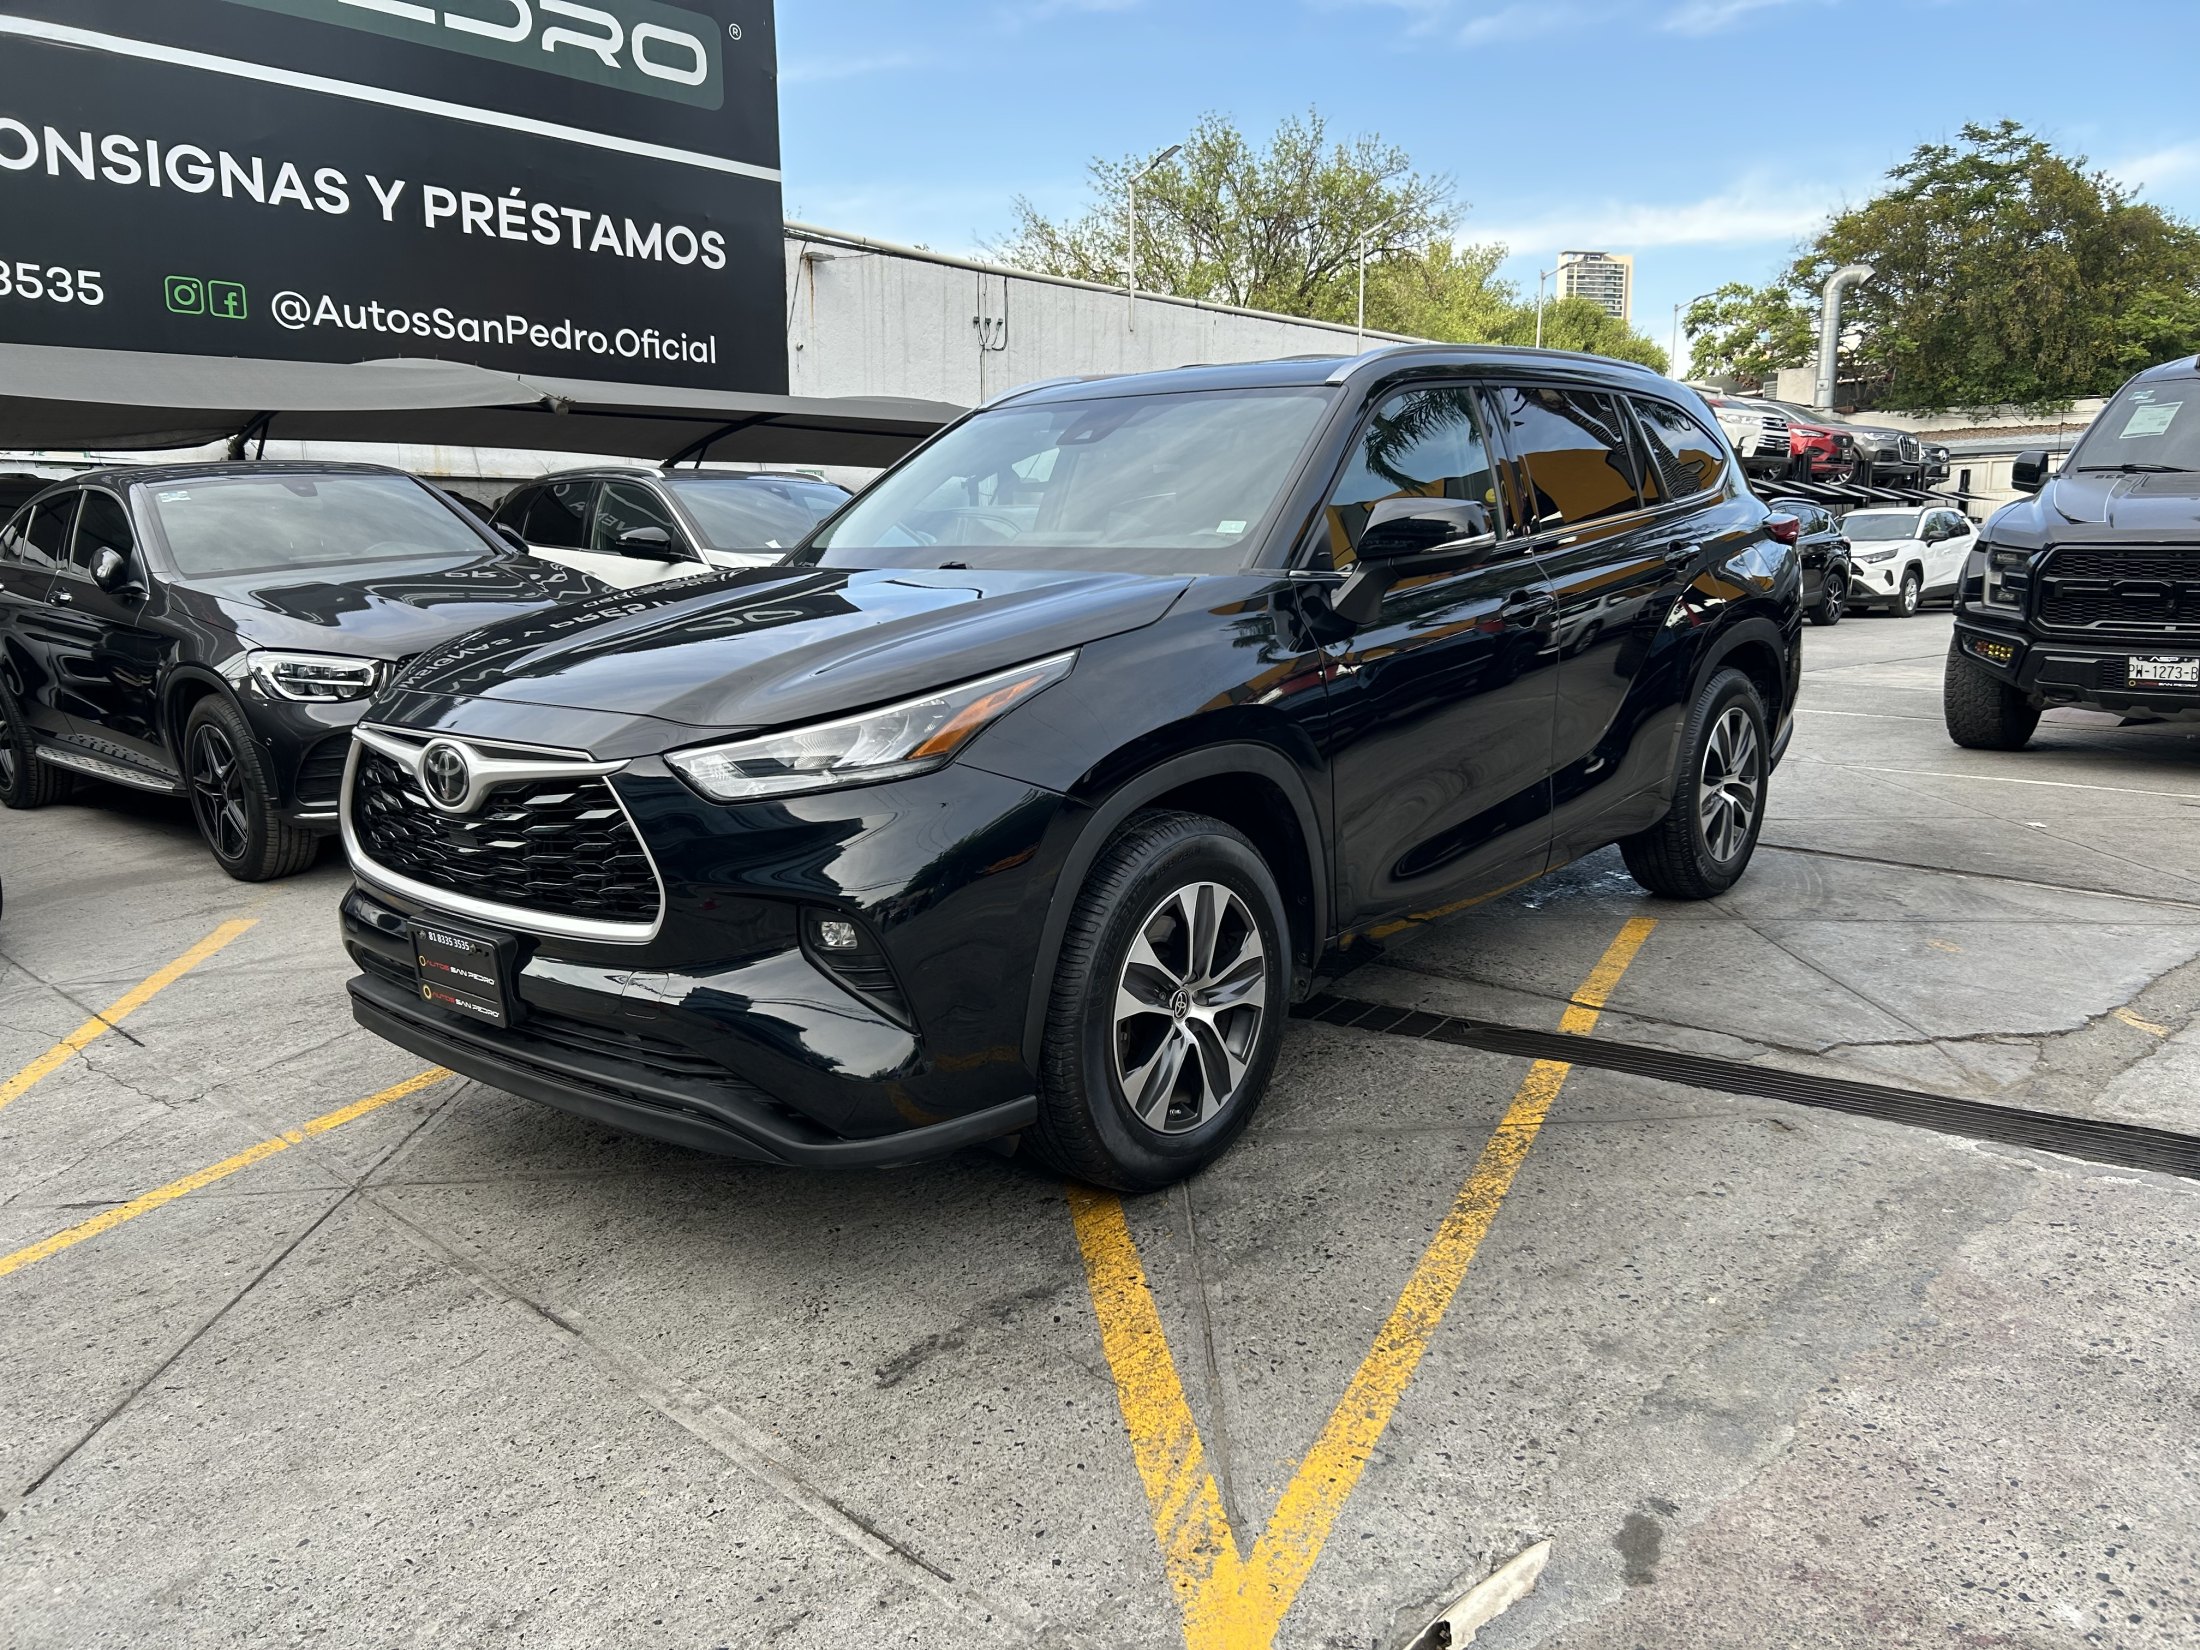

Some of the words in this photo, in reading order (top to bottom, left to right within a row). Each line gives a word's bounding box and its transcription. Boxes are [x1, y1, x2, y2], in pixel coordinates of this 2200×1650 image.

[365, 175, 405, 221] Y
[424, 186, 727, 270] PRÉSTAMOS
[272, 290, 717, 364] @AutosSanPedro.Oficial
[2128, 664, 2198, 680] PW-1273-B
[428, 931, 437, 942] 81
[437, 934, 453, 948] 8335
[453, 938, 470, 951] 3535
[426, 959, 450, 971] AUTOS
[450, 966, 467, 977] SAN
[468, 971, 495, 985] PEDRO
[432, 991, 456, 1004] AUTOS
[455, 998, 472, 1009] SAN
[472, 1004, 500, 1018] PEDRO
